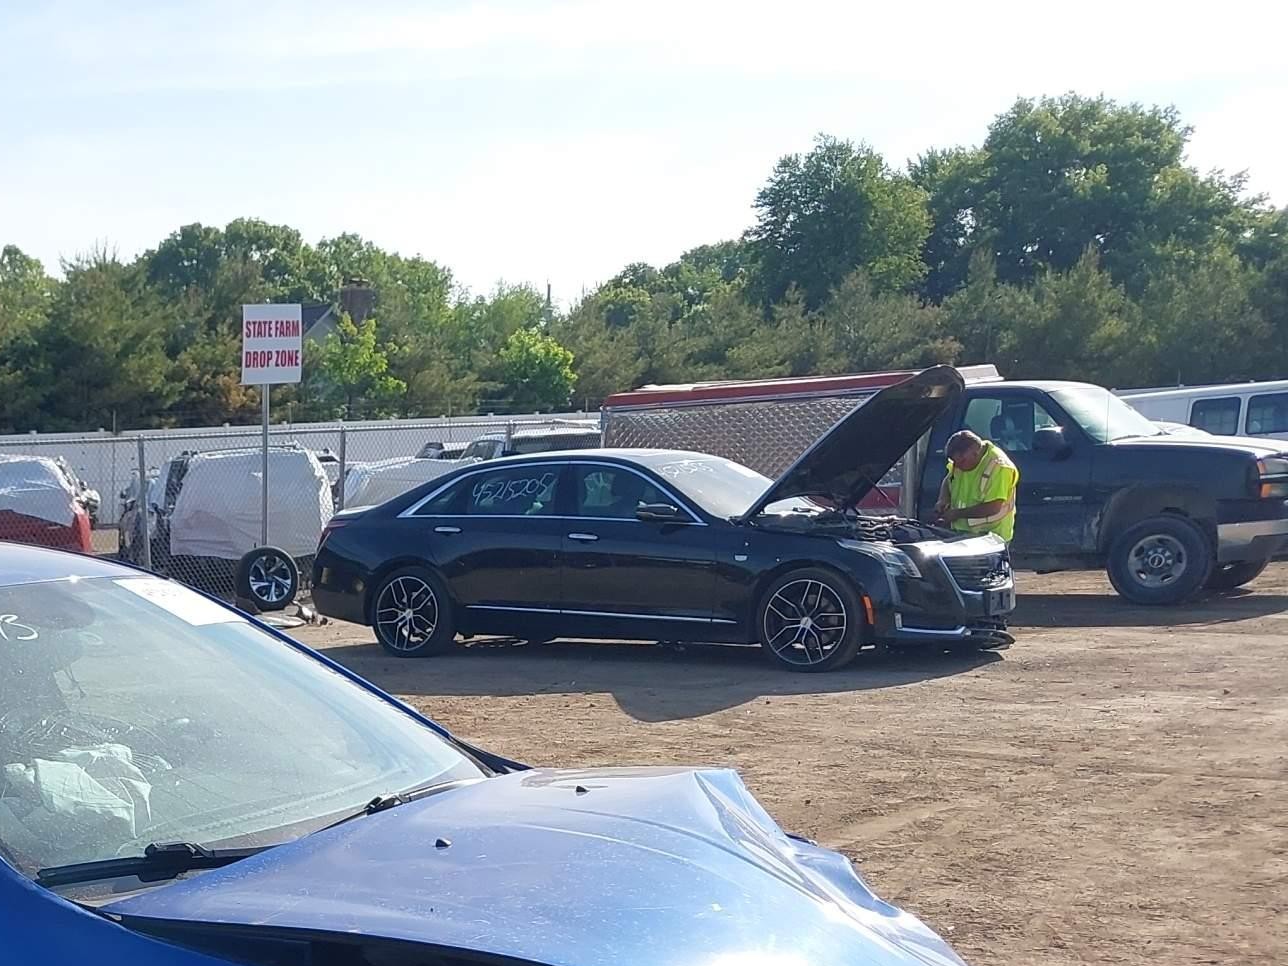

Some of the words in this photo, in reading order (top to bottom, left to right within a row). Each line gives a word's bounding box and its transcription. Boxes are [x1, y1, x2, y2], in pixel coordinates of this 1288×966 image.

[245, 320, 273, 338] STATE
[274, 320, 300, 338] FARM
[245, 350, 273, 369] DROP
[274, 350, 300, 367] ZONE
[472, 472, 554, 504] 45215205
